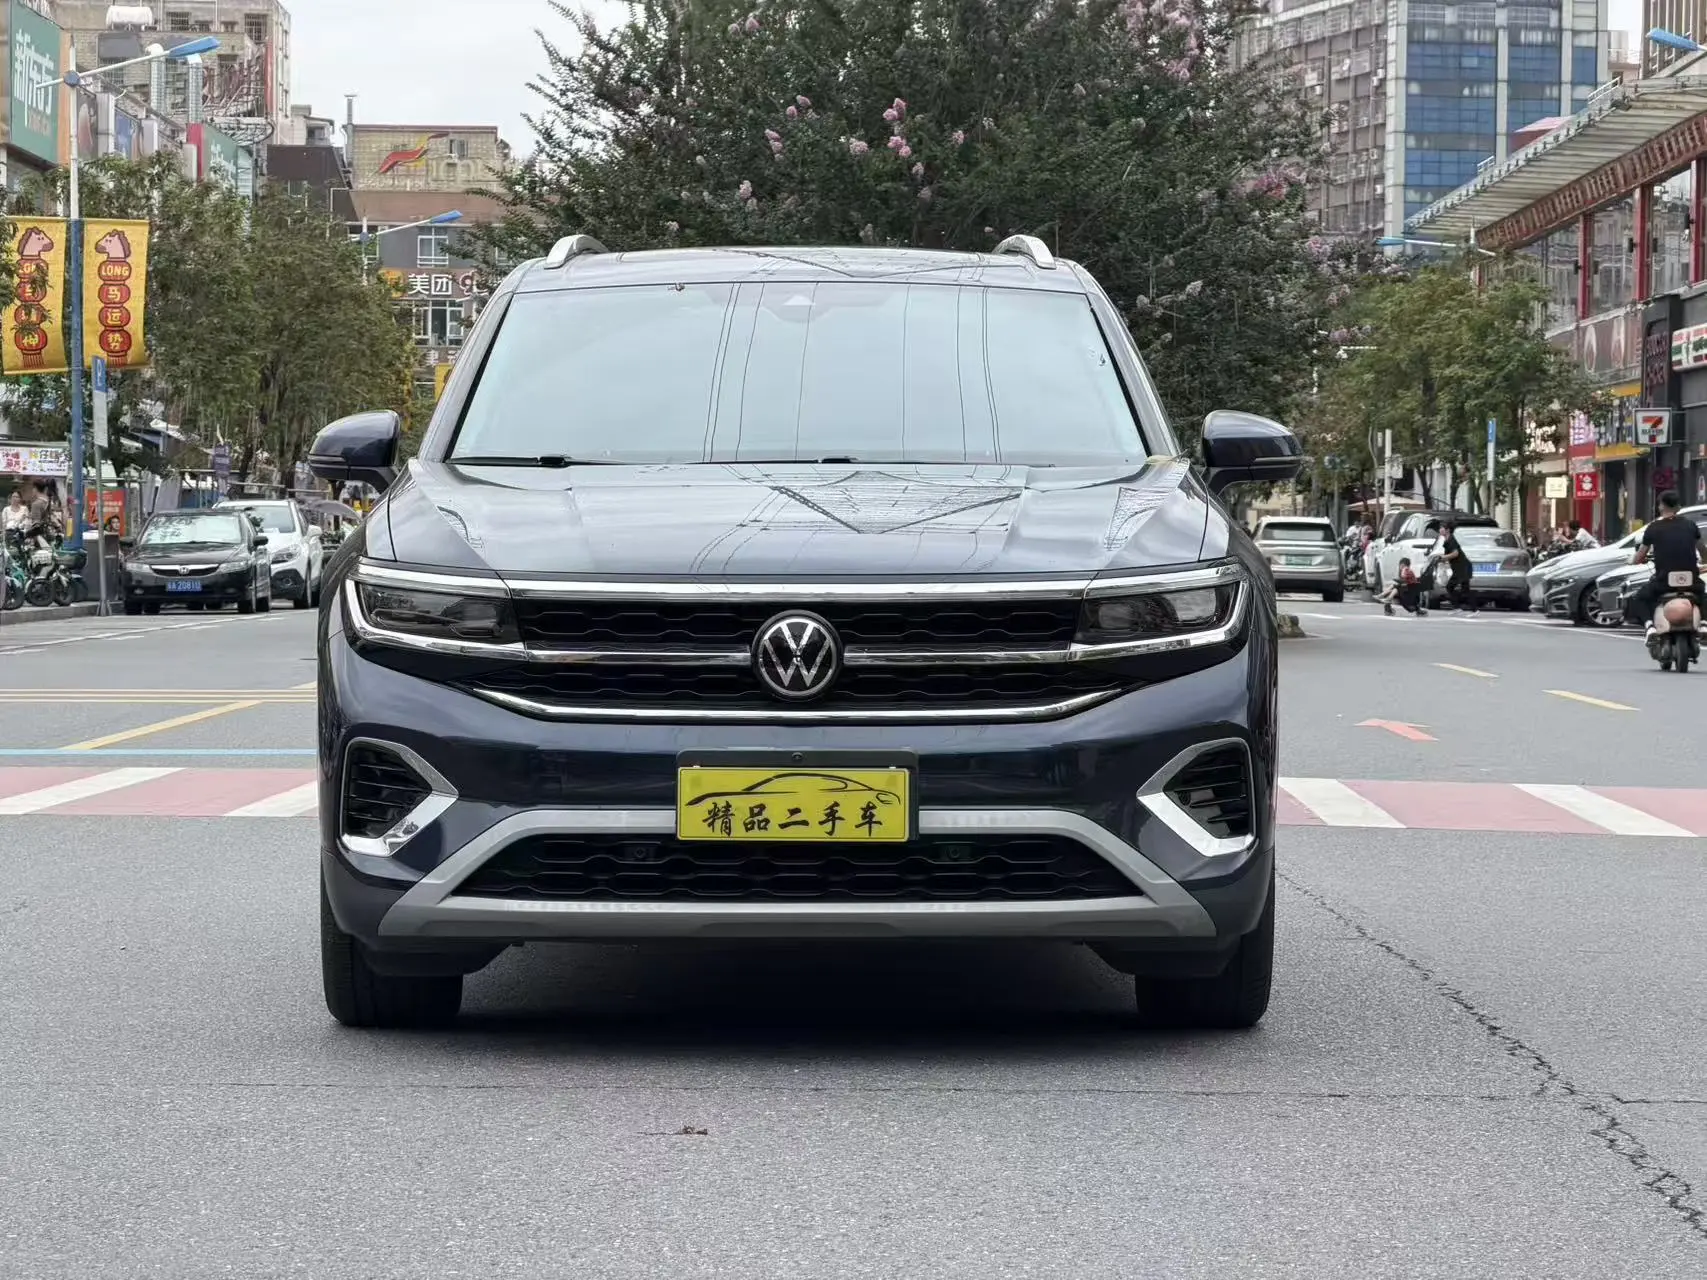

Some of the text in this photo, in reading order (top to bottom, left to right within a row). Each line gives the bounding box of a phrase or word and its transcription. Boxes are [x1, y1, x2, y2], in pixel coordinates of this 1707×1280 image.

[101, 265, 129, 276] LONG
[408, 273, 452, 295] 美团
[1641, 415, 1663, 443] 7
[702, 800, 883, 837] 精品二手车
